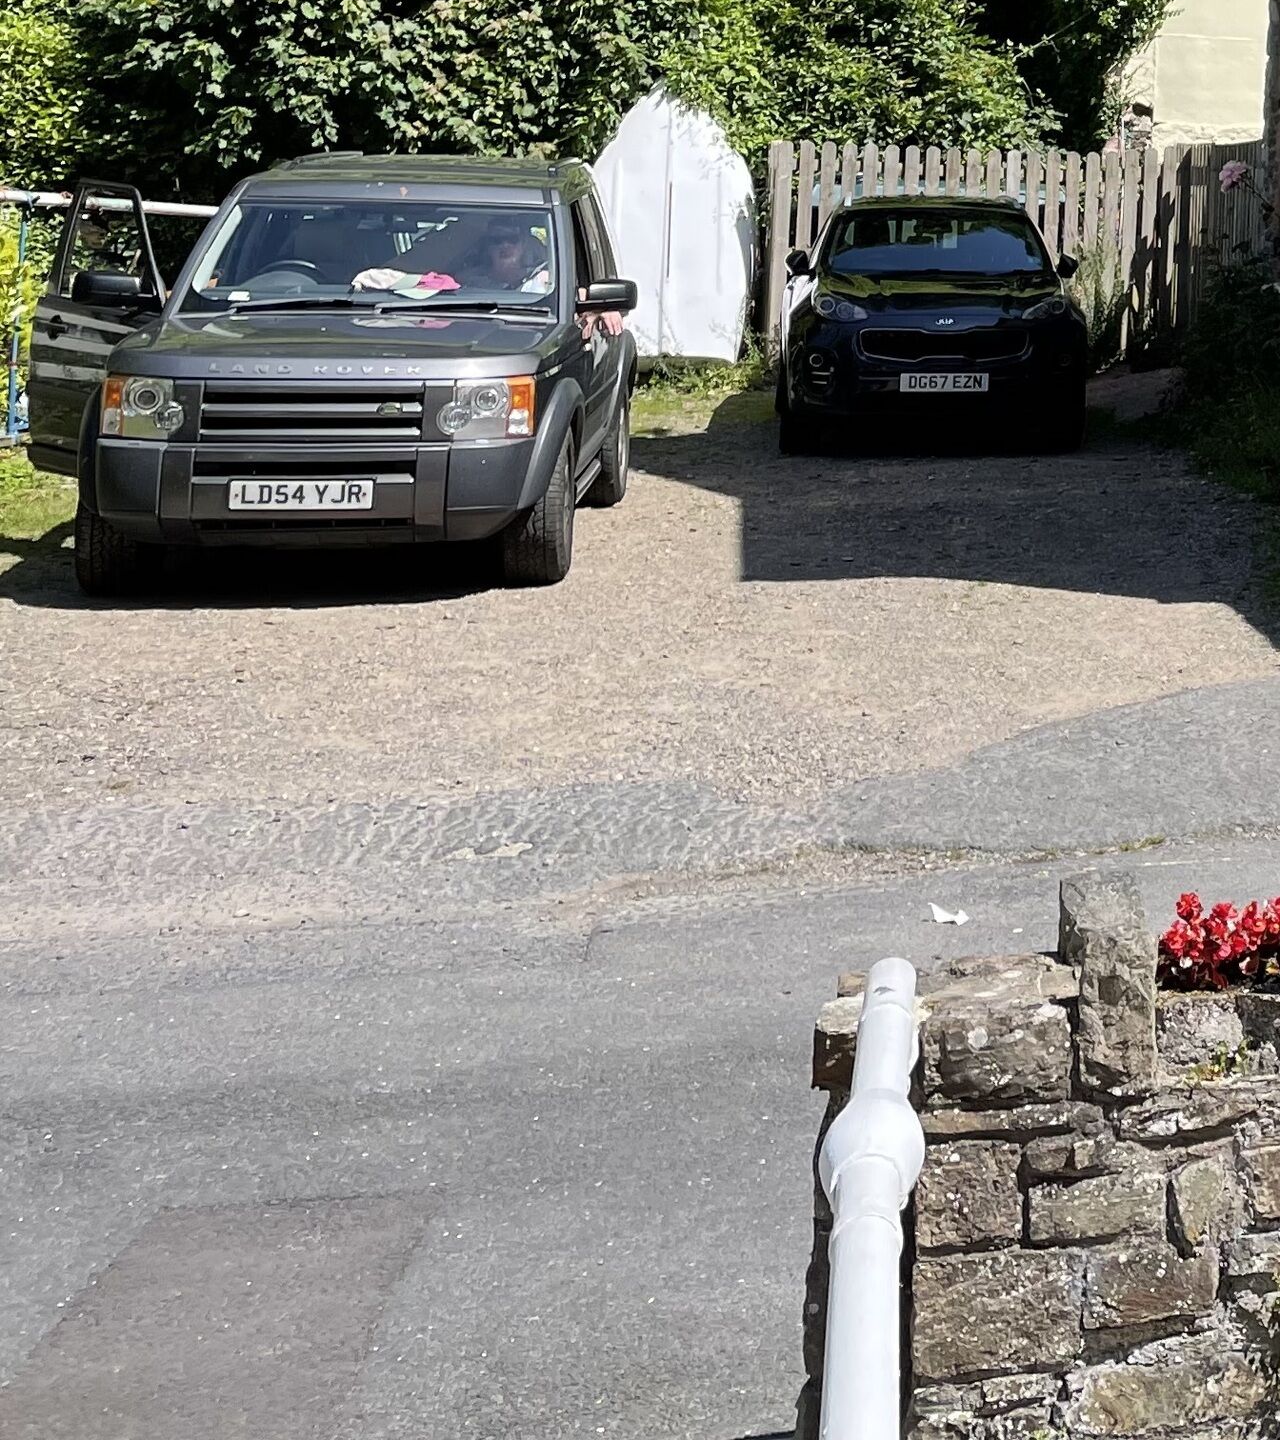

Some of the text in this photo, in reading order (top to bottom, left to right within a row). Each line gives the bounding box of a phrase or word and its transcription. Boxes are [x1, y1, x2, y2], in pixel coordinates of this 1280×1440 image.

[208, 363, 421, 375] LAND ROVER
[908, 375, 983, 389] DG67 EZN
[240, 484, 363, 505] LD54 YJR
